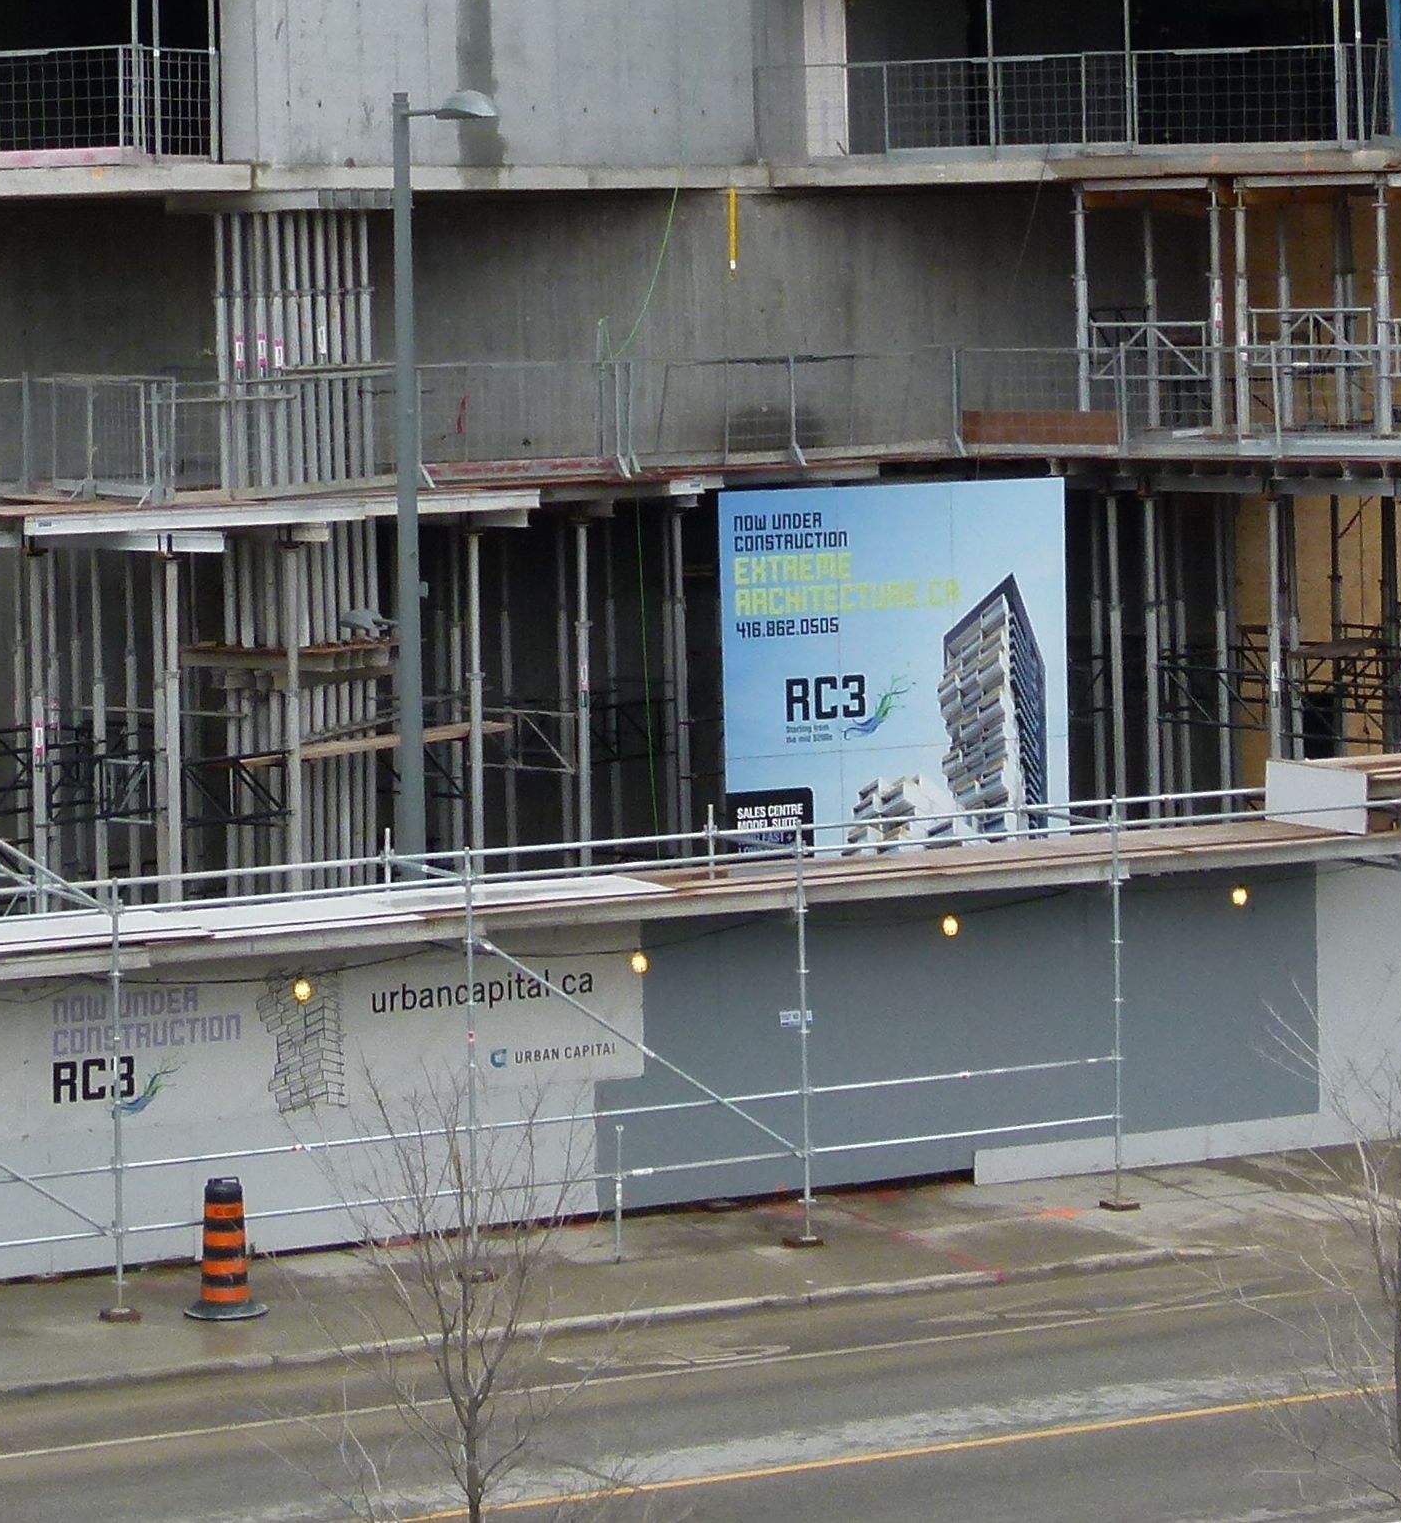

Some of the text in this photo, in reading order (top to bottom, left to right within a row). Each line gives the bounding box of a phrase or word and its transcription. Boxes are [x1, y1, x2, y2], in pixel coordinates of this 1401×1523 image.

[734, 512, 822, 532] NOW UNDER
[734, 531, 848, 552] CONSTRUCTION
[734, 552, 852, 586] EXTREME
[736, 617, 839, 638] 416.862.0505
[786, 674, 866, 722] RC3
[737, 803, 803, 819] SALES CENTRE
[737, 819, 768, 830] MODEL
[52, 986, 199, 1023] NOW UNDER
[371, 969, 593, 1013] urbancapitalca
[52, 1013, 241, 1056] CONSTRUCTION
[515, 1048, 559, 1064] URBAN
[53, 1055, 134, 1104] RC3
